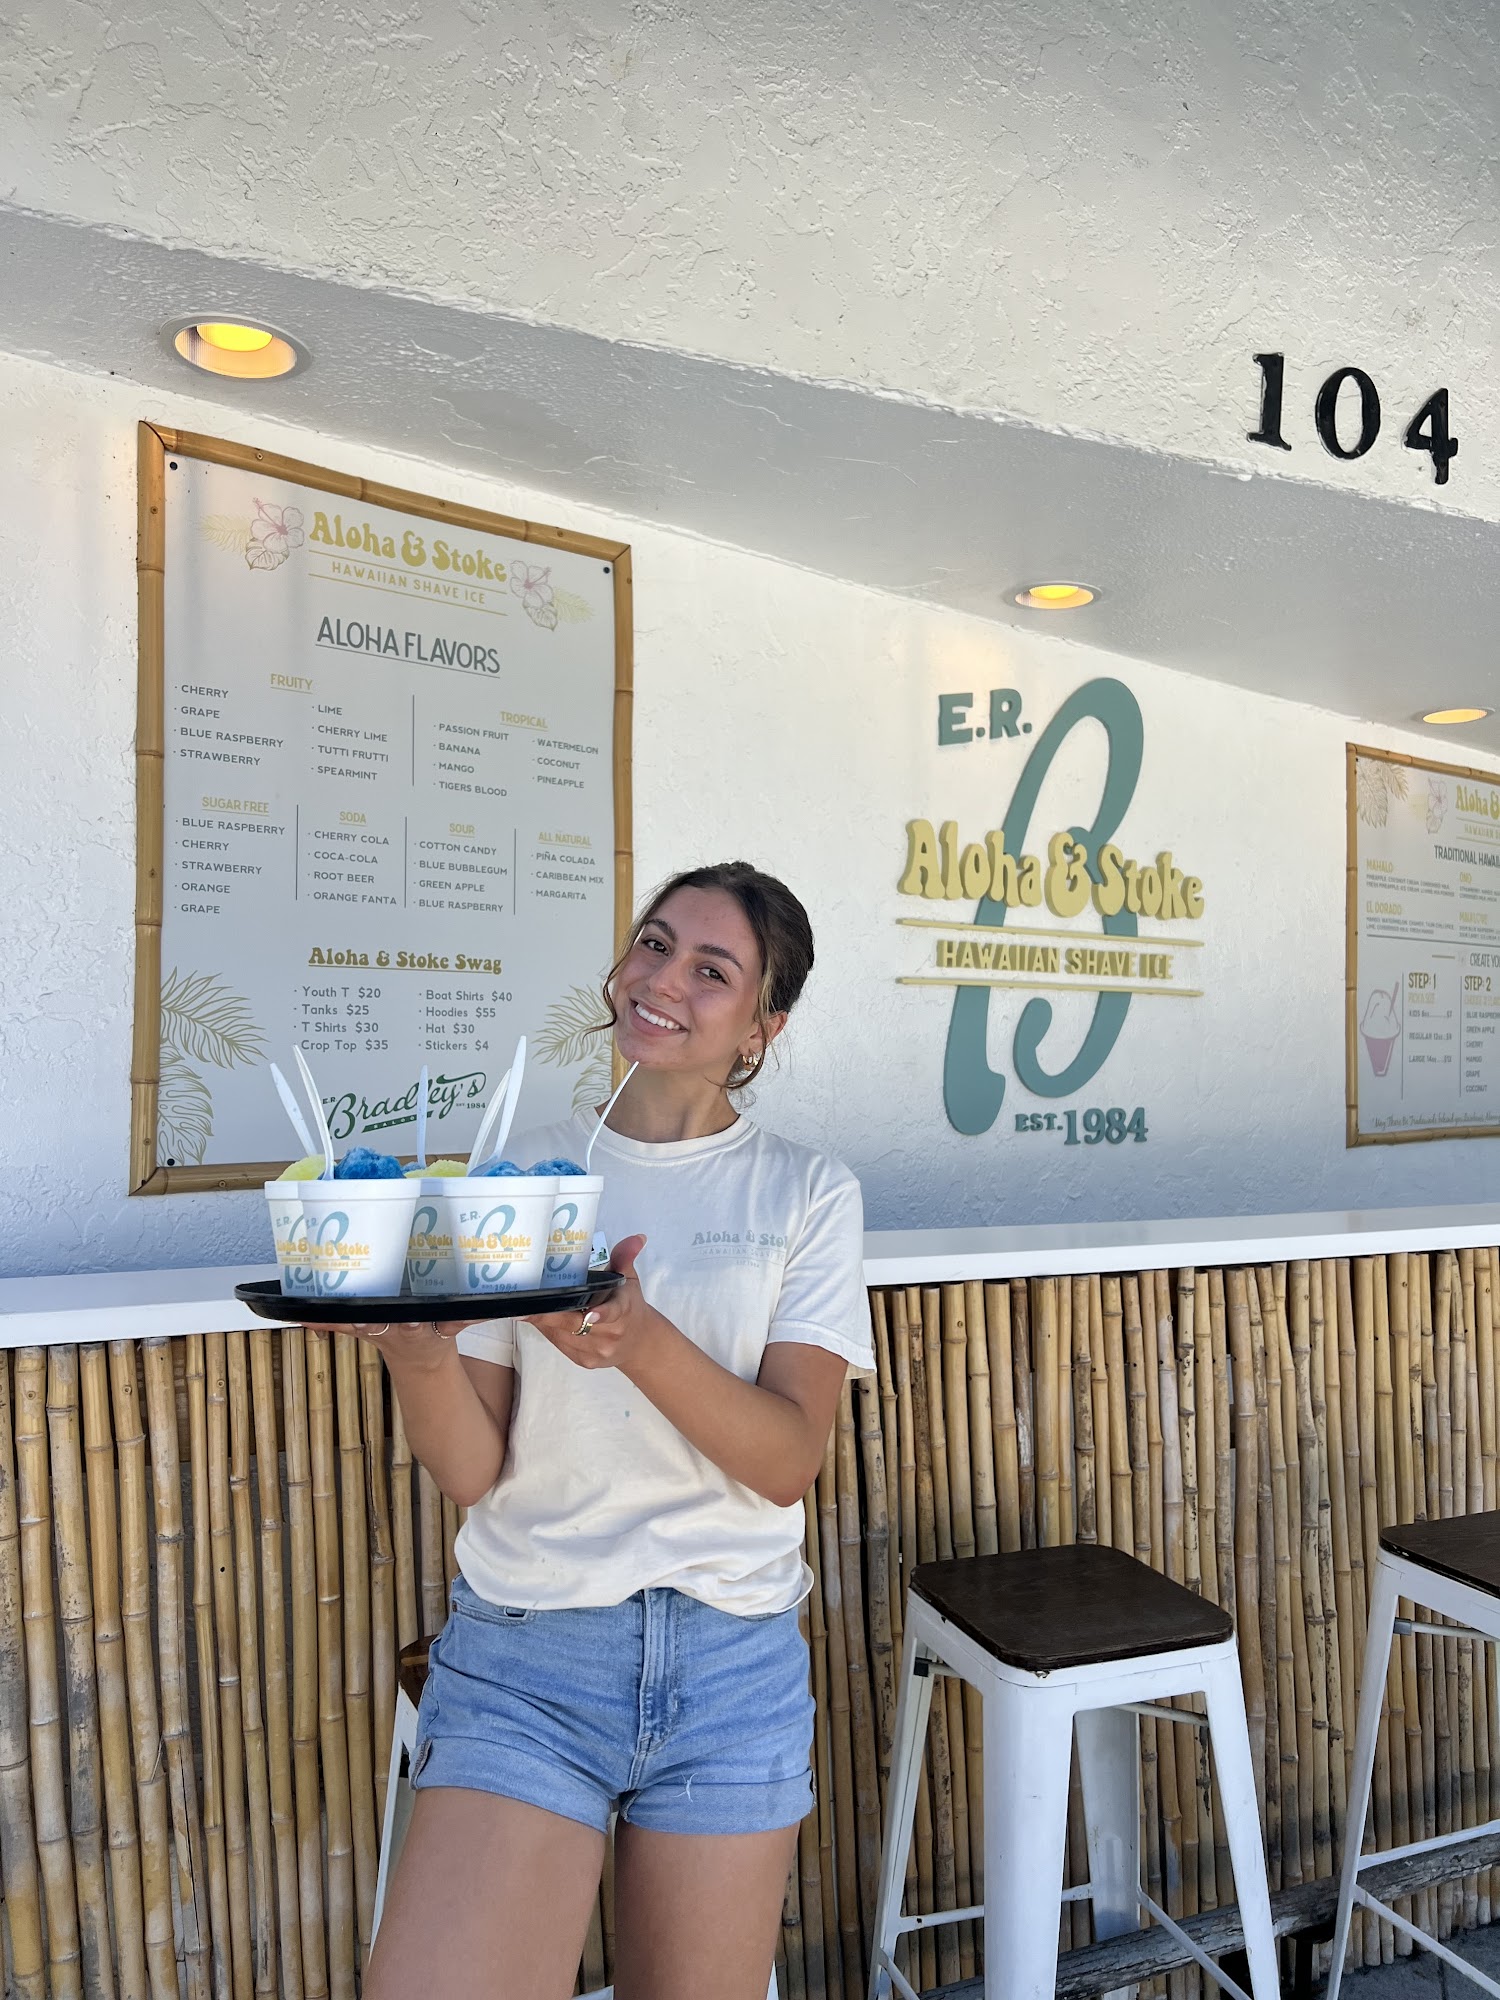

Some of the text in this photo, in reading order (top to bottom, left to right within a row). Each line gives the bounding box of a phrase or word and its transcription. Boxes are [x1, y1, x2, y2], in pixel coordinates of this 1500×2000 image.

[1247, 352, 1458, 485] 104
[309, 511, 507, 582] Aloha & Stoke
[332, 562, 485, 604] HAWAIIAN SHAVE ICE
[317, 616, 500, 674] ALOHA FLAVORS
[270, 673, 313, 690] FRUITY
[181, 684, 229, 699] CHERRY
[181, 706, 220, 719] GRAPE
[318, 704, 342, 716] LIME
[938, 688, 1033, 745] E.R.
[500, 711, 548, 728] TROPICAL
[180, 727, 284, 748] BLUE RASPBERRY
[318, 725, 387, 742] CHERRY LIME
[439, 723, 509, 741] PASSION FRUIT
[318, 745, 389, 762] TUTTI FRUTTI
[439, 743, 481, 756] BANANA
[537, 738, 599, 755] WATERMELON
[180, 749, 261, 766] STRAWBERRY
[537, 757, 580, 770] COCONUT
[317, 766, 378, 781] SPEARMINT
[438, 762, 475, 774] MANGO
[439, 781, 507, 797] TIGERS BLOOD
[537, 776, 584, 789] PINEAPPLE
[202, 797, 269, 813] SUGAR FREE
[1455, 784, 1488, 816] Aloha
[339, 811, 367, 824] SODA
[182, 818, 285, 835] BLUE RASPBERRY
[449, 823, 475, 835] SOUR
[182, 839, 230, 851] CHERRY
[314, 831, 389, 845] CHERRY COLA
[538, 831, 592, 846] ALL NATURAL
[419, 841, 497, 856] COTTON CANDY
[1434, 845, 1477, 865] TRADITIONAL
[314, 851, 378, 864] COCA-COLA
[536, 851, 595, 865] PIÑA COLADA
[182, 861, 262, 875] STRAWBERRY
[419, 860, 508, 876] BLUE BUBBLEGUM
[899, 819, 1205, 920] Aloha & Stoke
[314, 871, 375, 884] ROOT BEER
[536, 871, 604, 884] CARIBBEAN MIX
[181, 883, 231, 894] ORANGE
[419, 880, 485, 892] GREEN APPLE
[313, 892, 397, 905] ORANGE FANTA
[536, 890, 587, 900] MARGARITA
[181, 904, 220, 914] GRAPE
[419, 899, 504, 912] BLUE RASPBERRY
[1375, 901, 1402, 915] DORADO
[309, 947, 502, 975] Aloha & Stoke Swag
[937, 939, 1174, 979] HAWAIIAN SHAVE ICE
[1470, 953, 1490, 967] CREATE
[303, 986, 381, 998] Youth T $20
[426, 989, 513, 1002] Boat Shirts $40
[302, 1004, 369, 1016] Tanks $25
[426, 1007, 496, 1018] Hoodies $55
[302, 1022, 379, 1034] T Shirts $30
[426, 1024, 475, 1035] Hat $30
[301, 1039, 389, 1052] Crop Top $35
[425, 1040, 489, 1051] Stickers $4
[373, 1114, 416, 1129] SALOO
[1015, 1107, 1148, 1146] EST. 1984
[691, 1230, 740, 1246] Aloha
